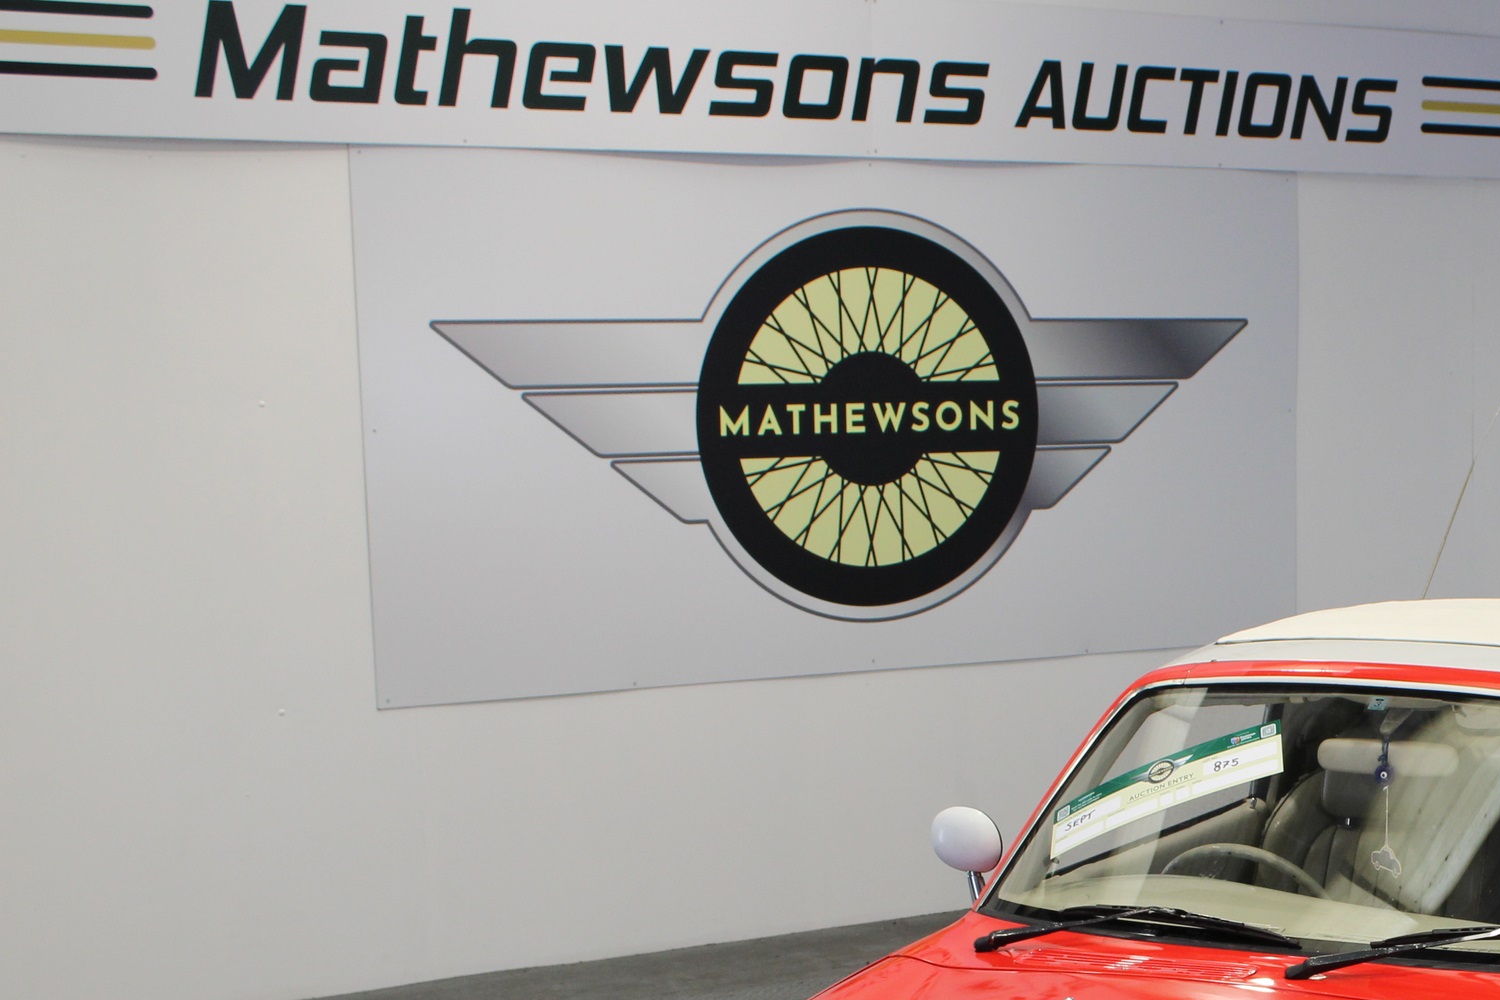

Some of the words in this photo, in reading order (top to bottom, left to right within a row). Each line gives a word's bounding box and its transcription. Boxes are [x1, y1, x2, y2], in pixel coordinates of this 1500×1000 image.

[195, 0, 989, 126] Mathewsons
[1015, 60, 1398, 143] AUCTIONS
[719, 401, 1020, 437] MATHEWSONS
[1214, 758, 1239, 772] 875
[1129, 784, 1166, 802] AUCTION
[1167, 773, 1194, 787] ENTRY
[1065, 809, 1096, 832] SEPT
